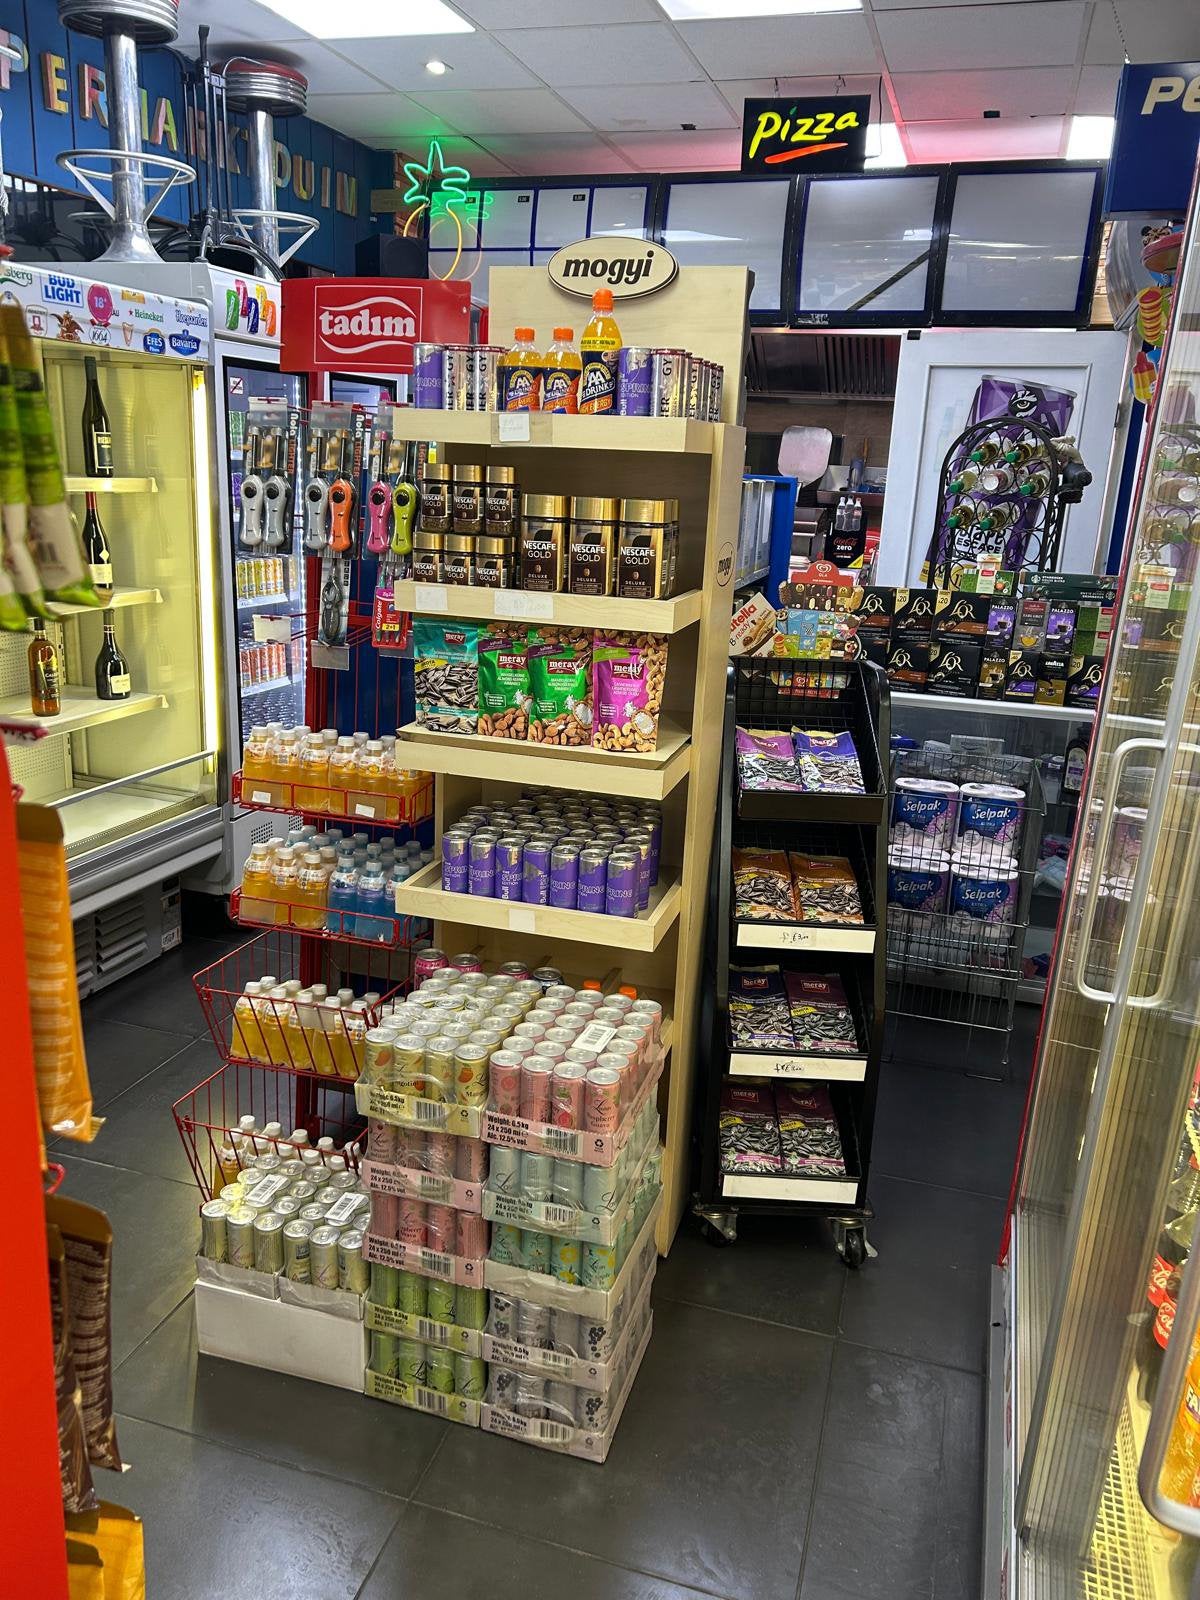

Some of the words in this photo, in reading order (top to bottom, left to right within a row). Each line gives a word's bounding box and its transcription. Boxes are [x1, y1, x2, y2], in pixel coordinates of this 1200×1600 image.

[749, 106, 859, 158] Pizza
[562, 250, 654, 284] mogyi
[48, 274, 75, 288] BUD
[44, 285, 82, 304] LIGHT
[134, 308, 164, 323] Heineken
[319, 309, 416, 337] tadım
[92, 329, 108, 342] 1664
[147, 336, 163, 347] EFES
[171, 337, 198, 349] Bavaria
[588, 370, 605, 387] AA
[586, 383, 609, 396] DRINK
[287, 438, 297, 475] LIGHTER
[353, 441, 363, 477] LIGHTER
[417, 444, 426, 480] LIGHTER
[956, 537, 1002, 554] ESCAPE
[527, 550, 552, 559] GOLD
[576, 553, 601, 562] GOLD
[625, 557, 650, 565] GOLD
[445, 633, 465, 641] meray
[499, 655, 527, 665] meray
[549, 661, 578, 670] meray
[903, 800, 941, 813] Selpak
[972, 807, 1011, 820] Selpak
[896, 880, 935, 892] Selpak
[962, 885, 1002, 900] Selpak
[802, 981, 828, 989] meray
[487, 1114, 511, 1126] Weight:
[521, 1122, 529, 1130] kg
[487, 1123, 495, 1131] 24
[500, 1127, 511, 1135] 250
[487, 1131, 499, 1139] Alc.
[382, 1177, 393, 1185] 250
[368, 1244, 375, 1252] 24
[380, 1247, 391, 1255] 250
[368, 1252, 379, 1260] Alc.
